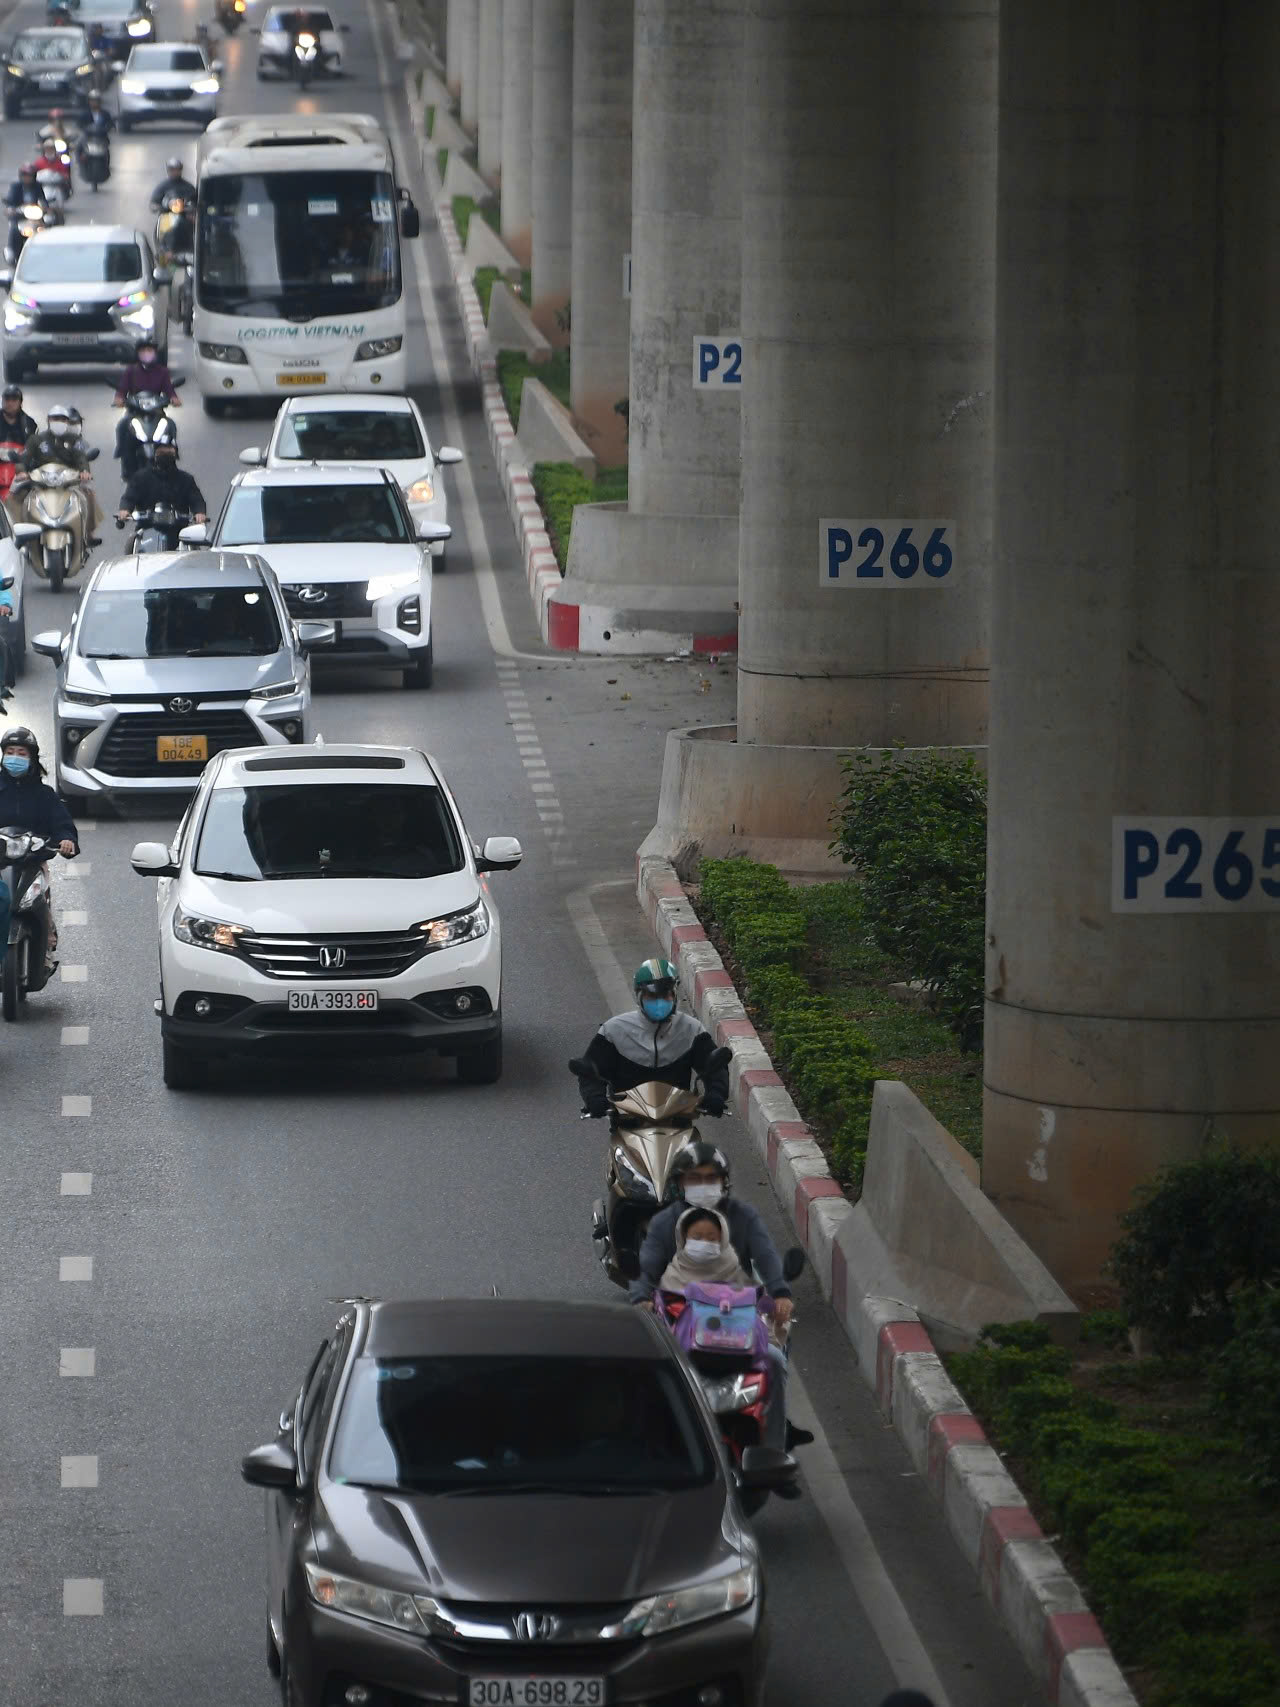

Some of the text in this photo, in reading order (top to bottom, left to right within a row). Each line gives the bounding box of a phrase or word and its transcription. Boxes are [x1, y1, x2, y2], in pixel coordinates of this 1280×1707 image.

[236, 324, 365, 340] LOGITEM VIETNAM
[827, 527, 953, 579] P266
[291, 992, 376, 1009] 30A-393.80
[473, 1680, 601, 1705] 30A-698.29
